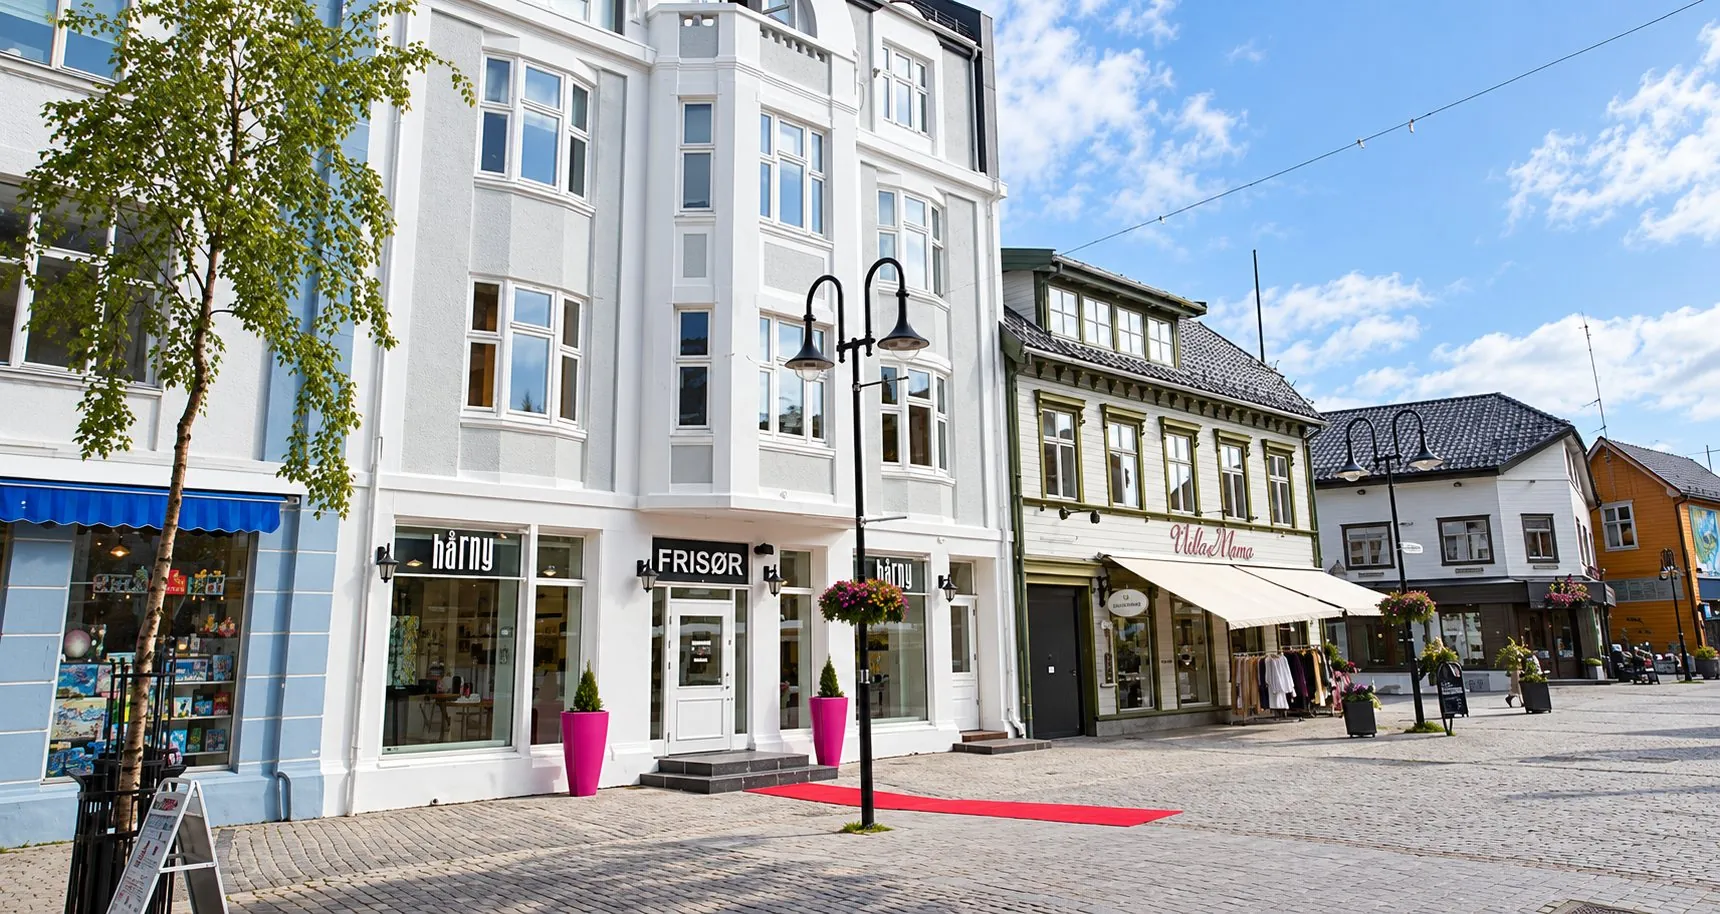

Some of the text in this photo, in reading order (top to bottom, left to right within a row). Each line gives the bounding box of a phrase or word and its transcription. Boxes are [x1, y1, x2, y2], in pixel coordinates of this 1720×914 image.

[432, 530, 494, 571] hårny
[1206, 527, 1254, 560] Mama
[658, 548, 743, 576] FRISØR
[876, 558, 912, 590] hårny
